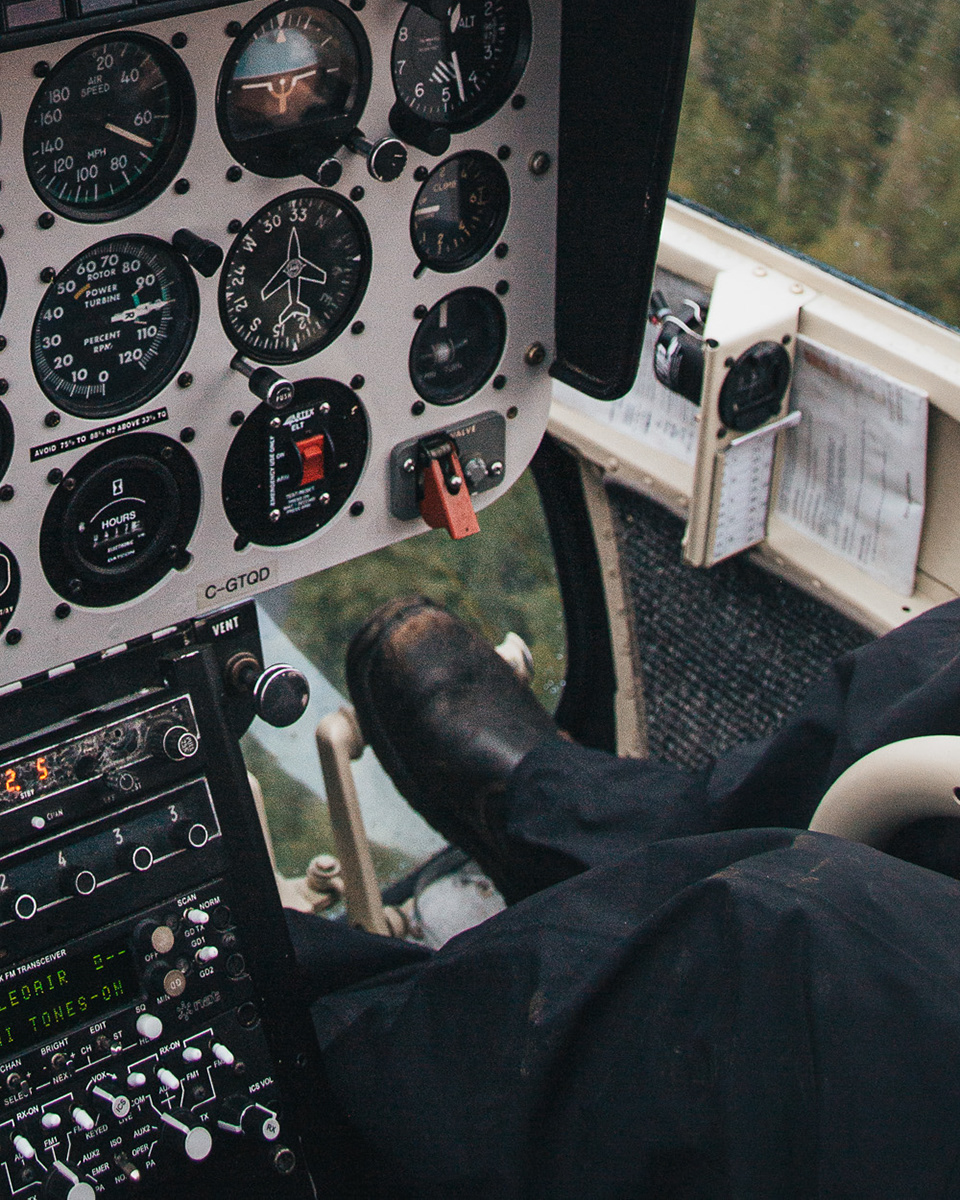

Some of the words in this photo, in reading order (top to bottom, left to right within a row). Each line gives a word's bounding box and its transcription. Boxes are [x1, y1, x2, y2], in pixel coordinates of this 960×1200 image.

[96, 54, 114, 71] 20
[133, 110, 153, 126] 60
[41, 136, 64, 155] 140
[53, 155, 74, 173] 120
[110, 154, 128, 171] 80
[76, 164, 99, 183] 100
[100, 254, 119, 268] 70
[122, 260, 141, 274] 80
[87, 268, 116, 282] ROTOR
[57, 280, 76, 295] 50
[85, 283, 118, 298] POWER
[84, 293, 121, 309] TURBINE
[42, 334, 62, 349] 30
[83, 330, 121, 346] PERCENT
[54, 354, 74, 370] 20
[118, 348, 143, 365] 120
[290, 421, 305, 432] ELT
[101, 510, 136, 530] HOURS
[205, 567, 270, 599] C-GTQD
[211, 616, 239, 636] VENT
[177, 893, 197, 907] SCAN
[199, 896, 221, 910] NORM
[5, 968, 16, 981] FM
[17, 948, 67, 976] TRANSCEIVER
[40, 1037, 70, 1056] BRIGHT
[0, 1058, 22, 1073] CHAN
[16, 1104, 39, 1121] RX-ON
